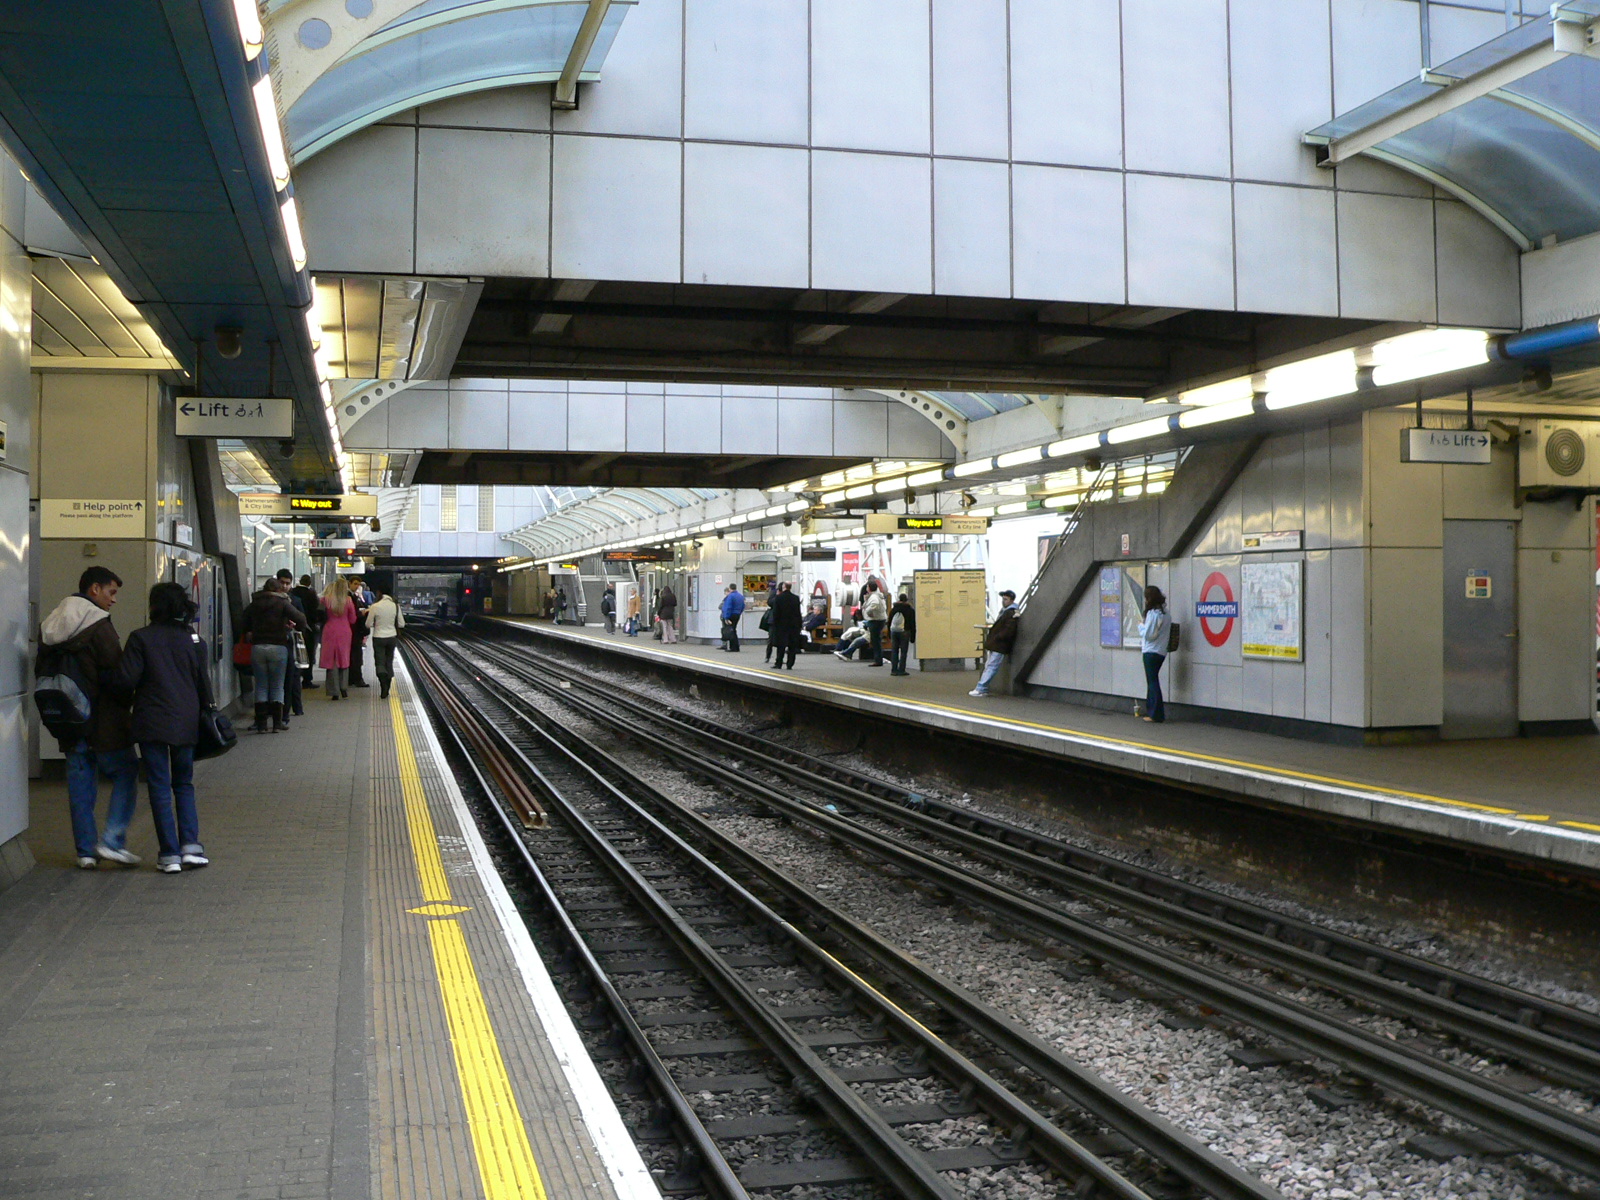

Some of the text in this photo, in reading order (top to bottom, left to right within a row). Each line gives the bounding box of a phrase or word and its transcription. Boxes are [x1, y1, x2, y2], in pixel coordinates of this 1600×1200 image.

[198, 402, 229, 417] Lift
[1453, 434, 1475, 447] Lift
[83, 502, 133, 512] Help point
[299, 499, 332, 509] Way out
[906, 518, 934, 528] Way out
[1100, 578, 1118, 591] Don't
[1101, 605, 1116, 617] time
[1197, 604, 1236, 615] HAMMERSMITH
